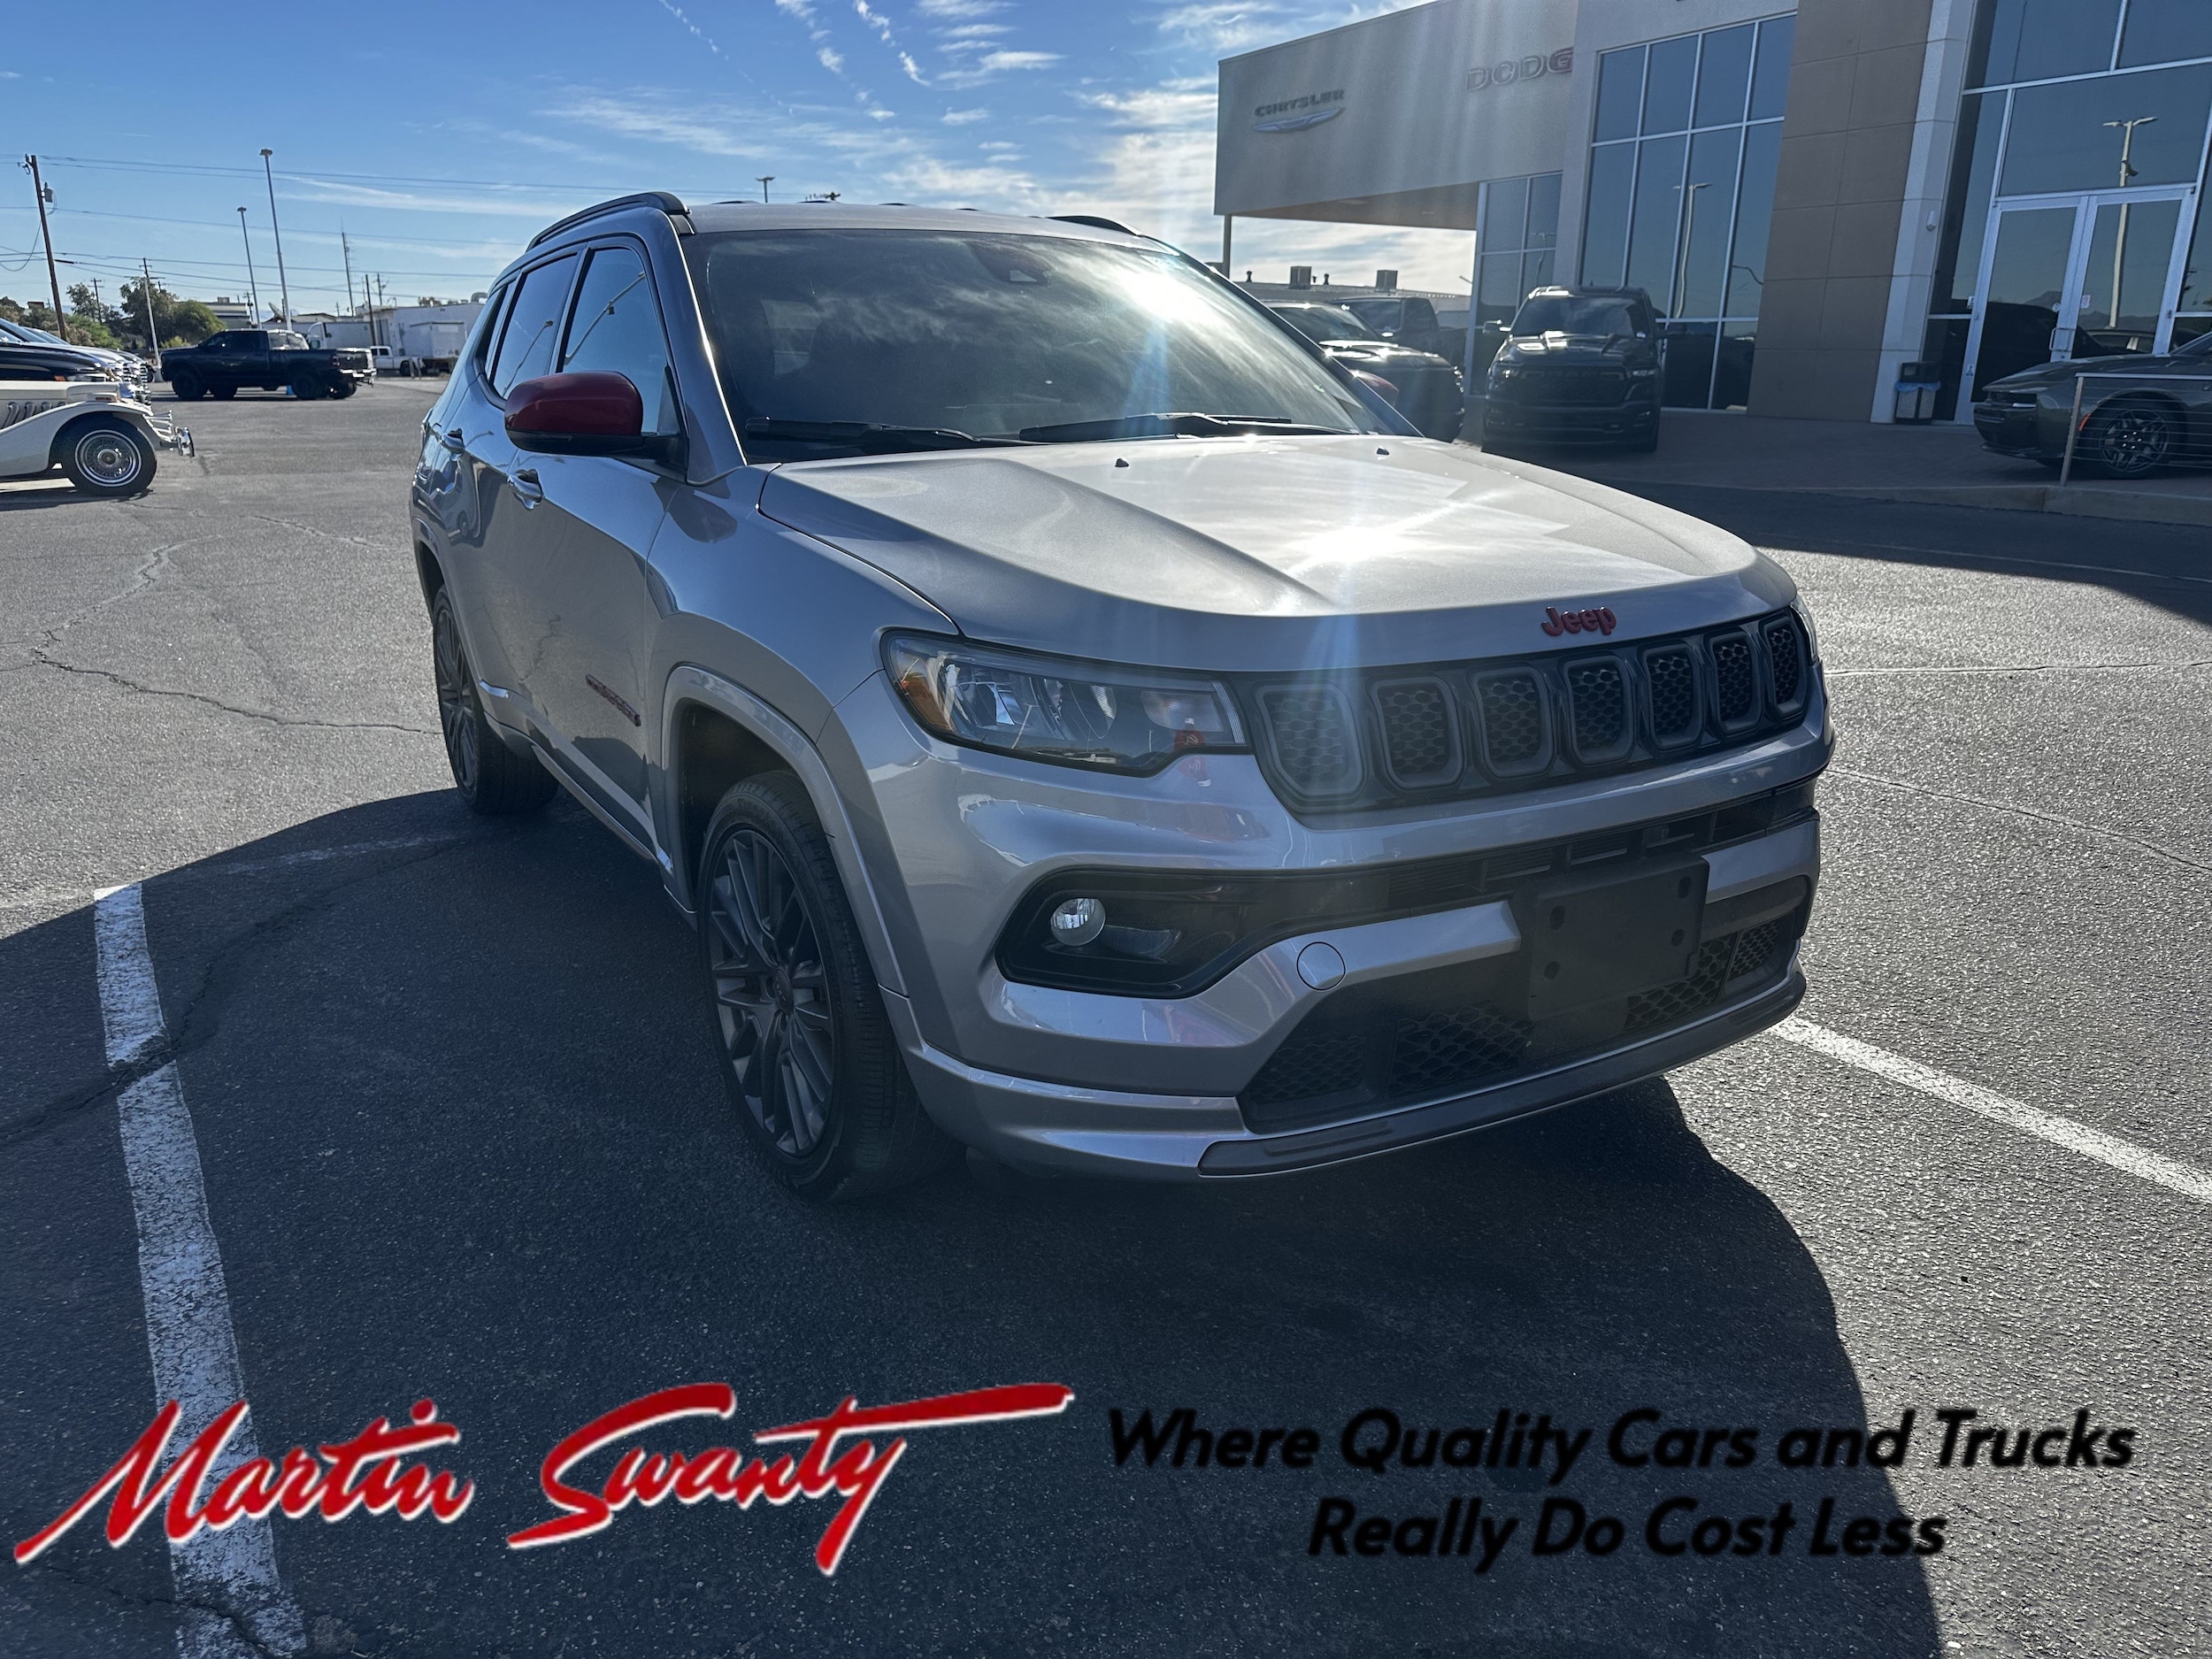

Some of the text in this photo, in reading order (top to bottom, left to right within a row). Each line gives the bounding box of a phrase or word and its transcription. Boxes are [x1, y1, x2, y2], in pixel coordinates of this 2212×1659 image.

[1465, 46, 1573, 90] DODG
[1254, 89, 1344, 117] CHRYSLER
[1540, 606, 1617, 636] Jeep
